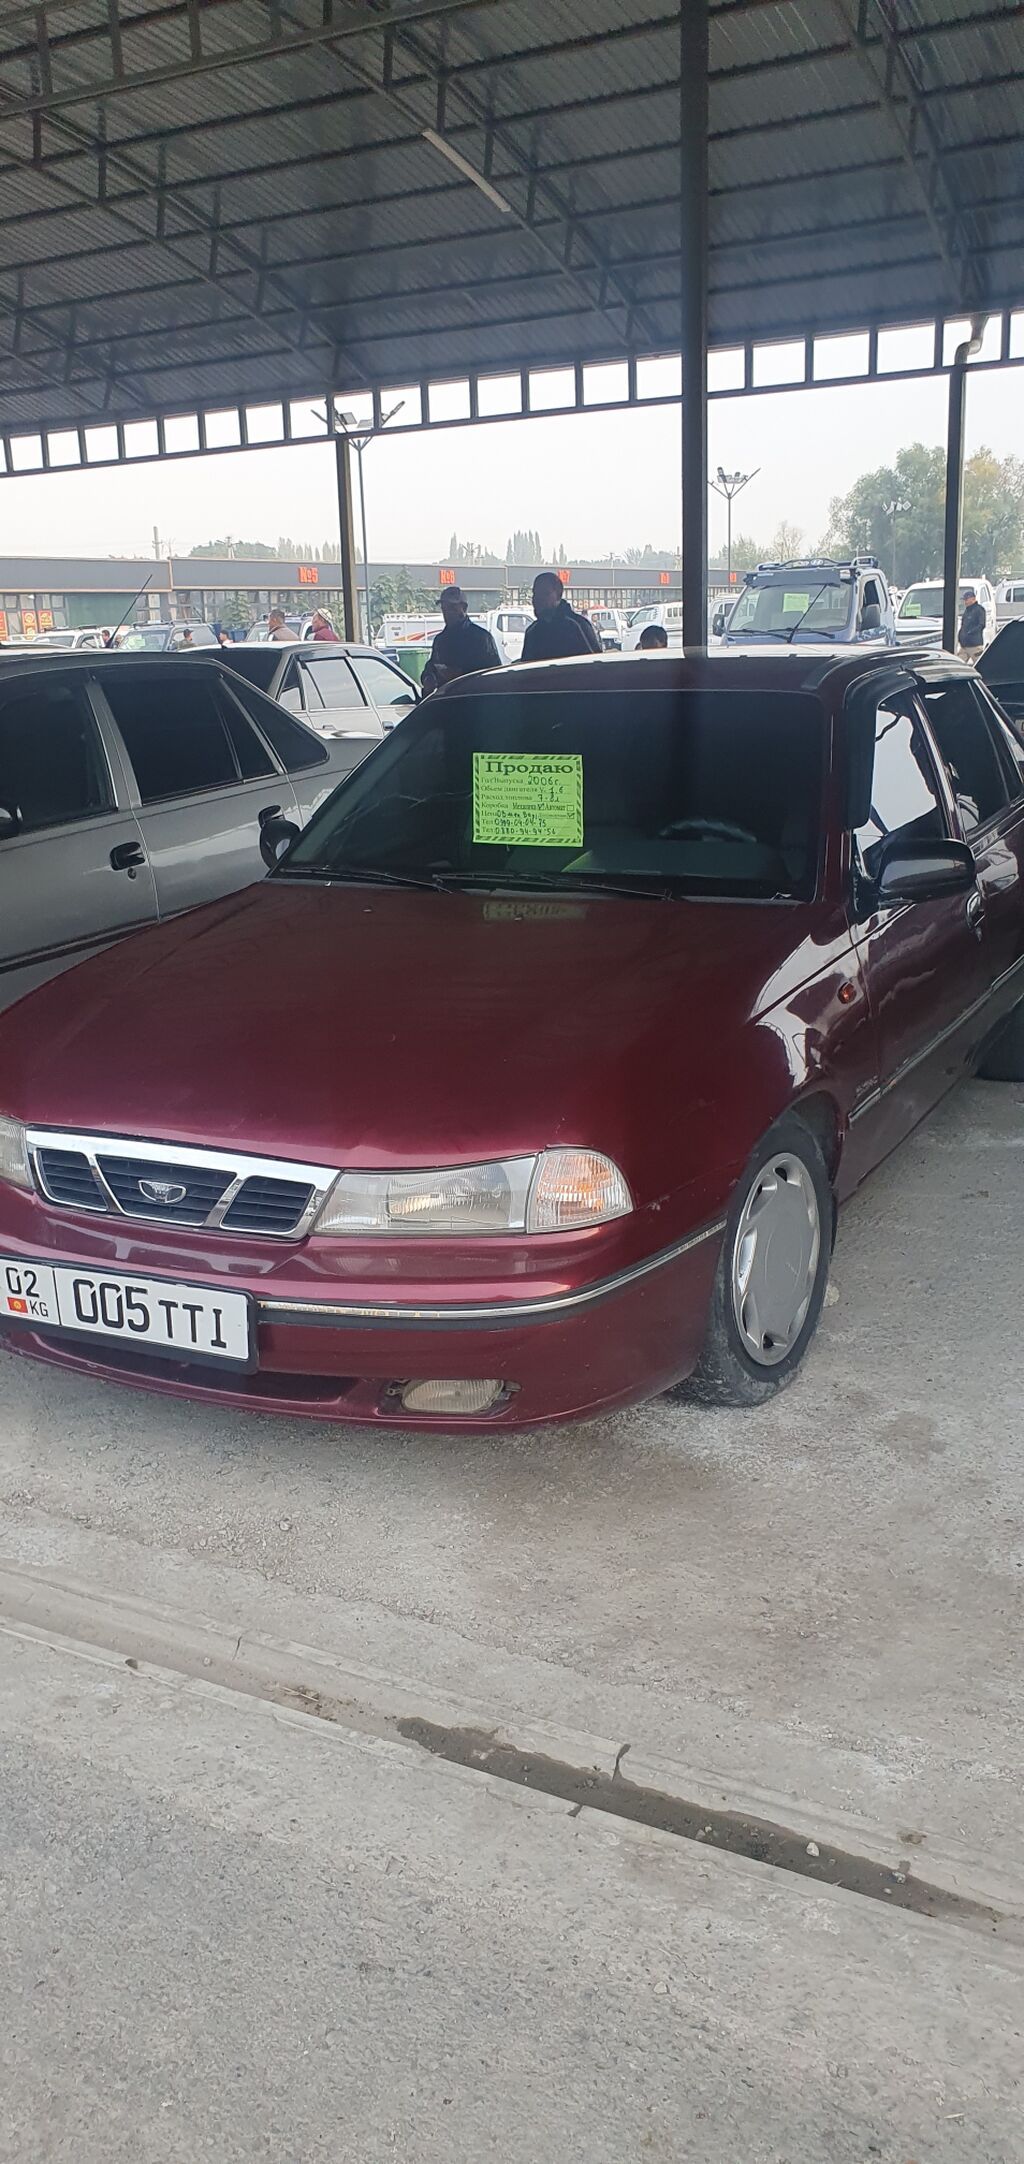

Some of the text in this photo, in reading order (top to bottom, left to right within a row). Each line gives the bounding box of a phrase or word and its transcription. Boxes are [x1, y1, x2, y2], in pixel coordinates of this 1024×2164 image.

[485, 760, 573, 776] Продаю
[5, 1267, 39, 1298] 02
[30, 1301, 49, 1317] KG
